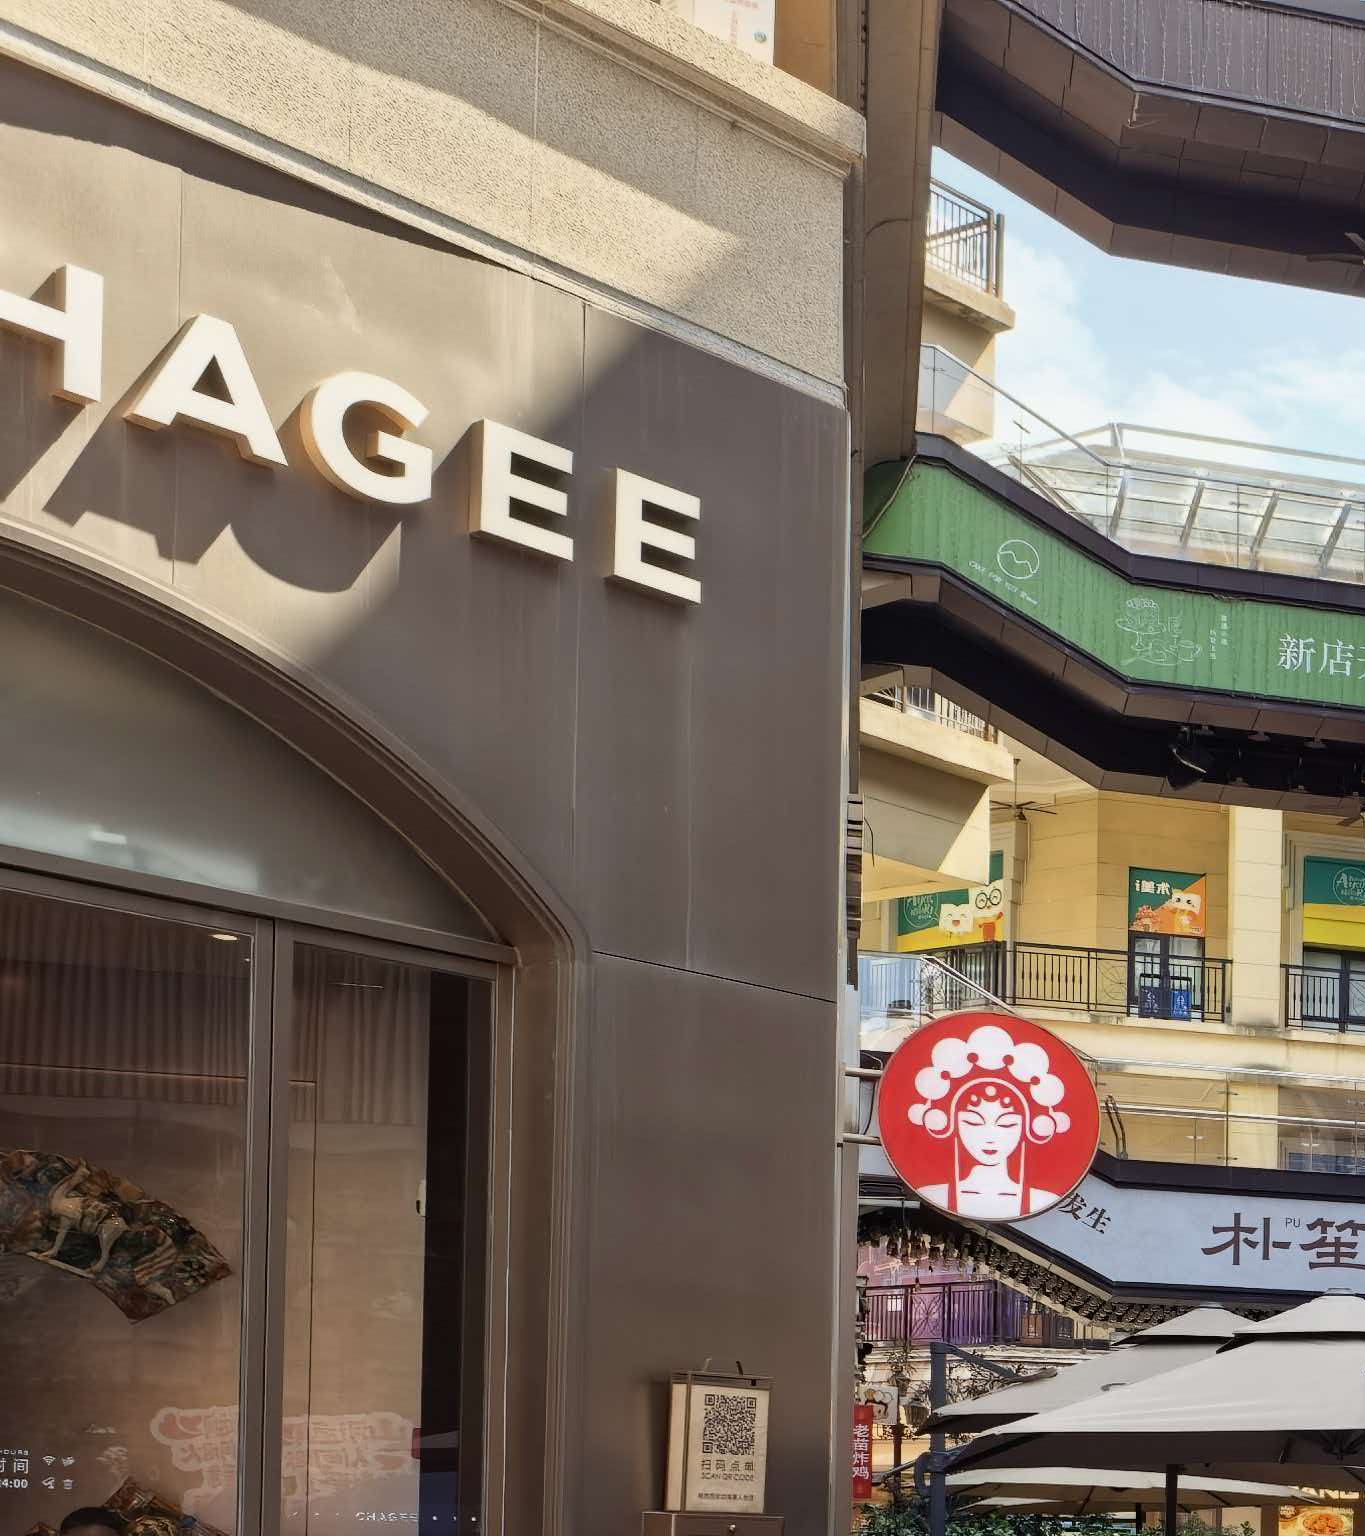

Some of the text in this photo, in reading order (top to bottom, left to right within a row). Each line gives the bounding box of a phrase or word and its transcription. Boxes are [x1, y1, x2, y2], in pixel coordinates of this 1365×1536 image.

[1285, 1217, 1301, 1229] PU
[852, 1423, 869, 1479] 老苗炸鸡
